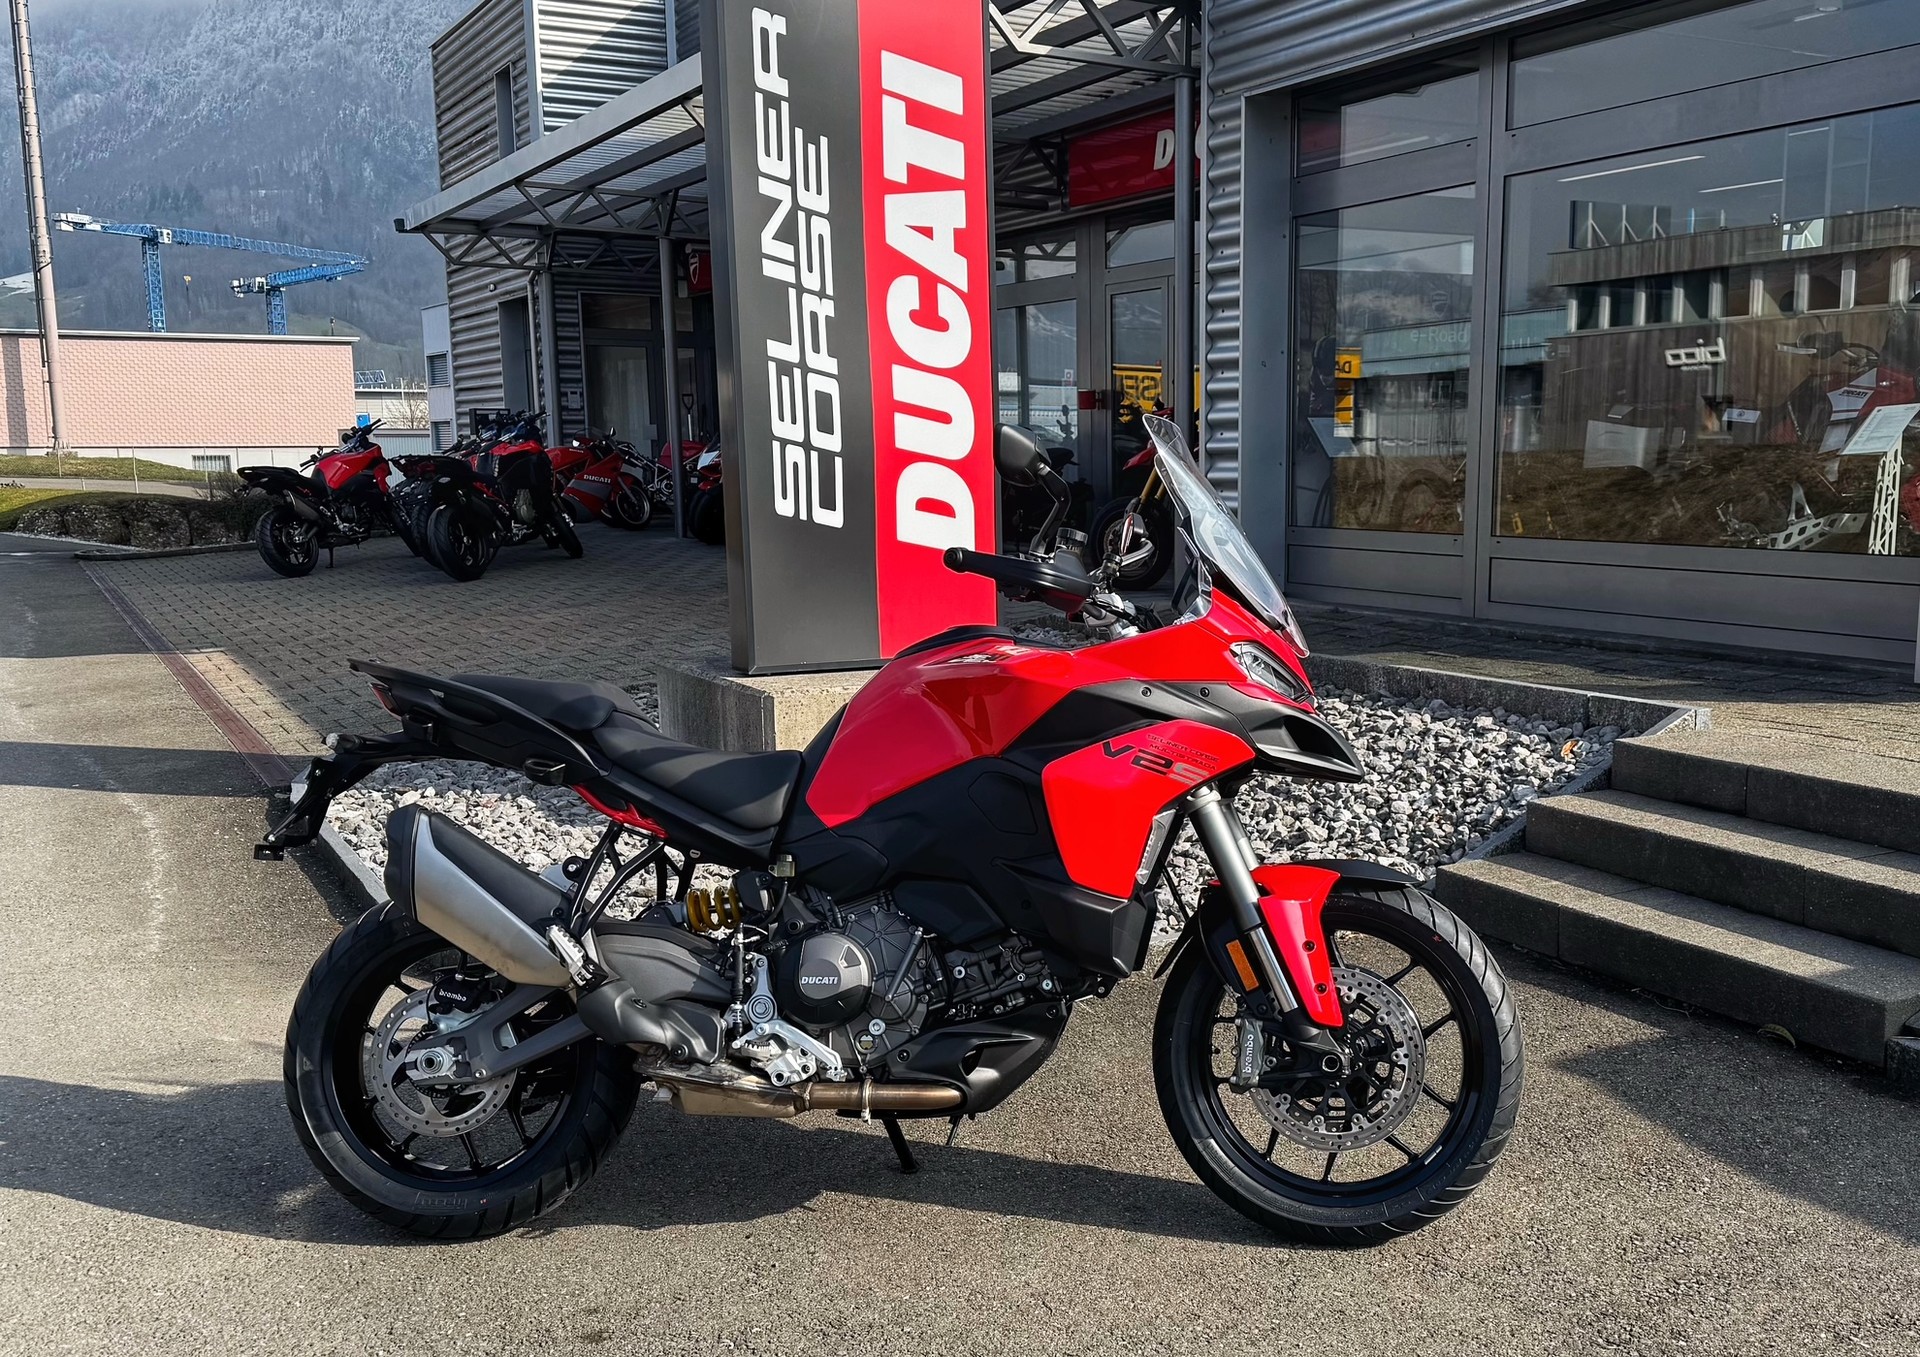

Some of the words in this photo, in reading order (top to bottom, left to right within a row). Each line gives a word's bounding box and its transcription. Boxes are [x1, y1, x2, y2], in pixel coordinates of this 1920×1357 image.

[752, 7, 807, 519] SELINER
[881, 50, 975, 551] DUCATI
[796, 127, 845, 528] CORSE
[583, 474, 611, 484] DUCATI
[439, 988, 467, 1001] brembo
[801, 976, 838, 985] DUCATI
[1243, 1034, 1254, 1073] brembo
